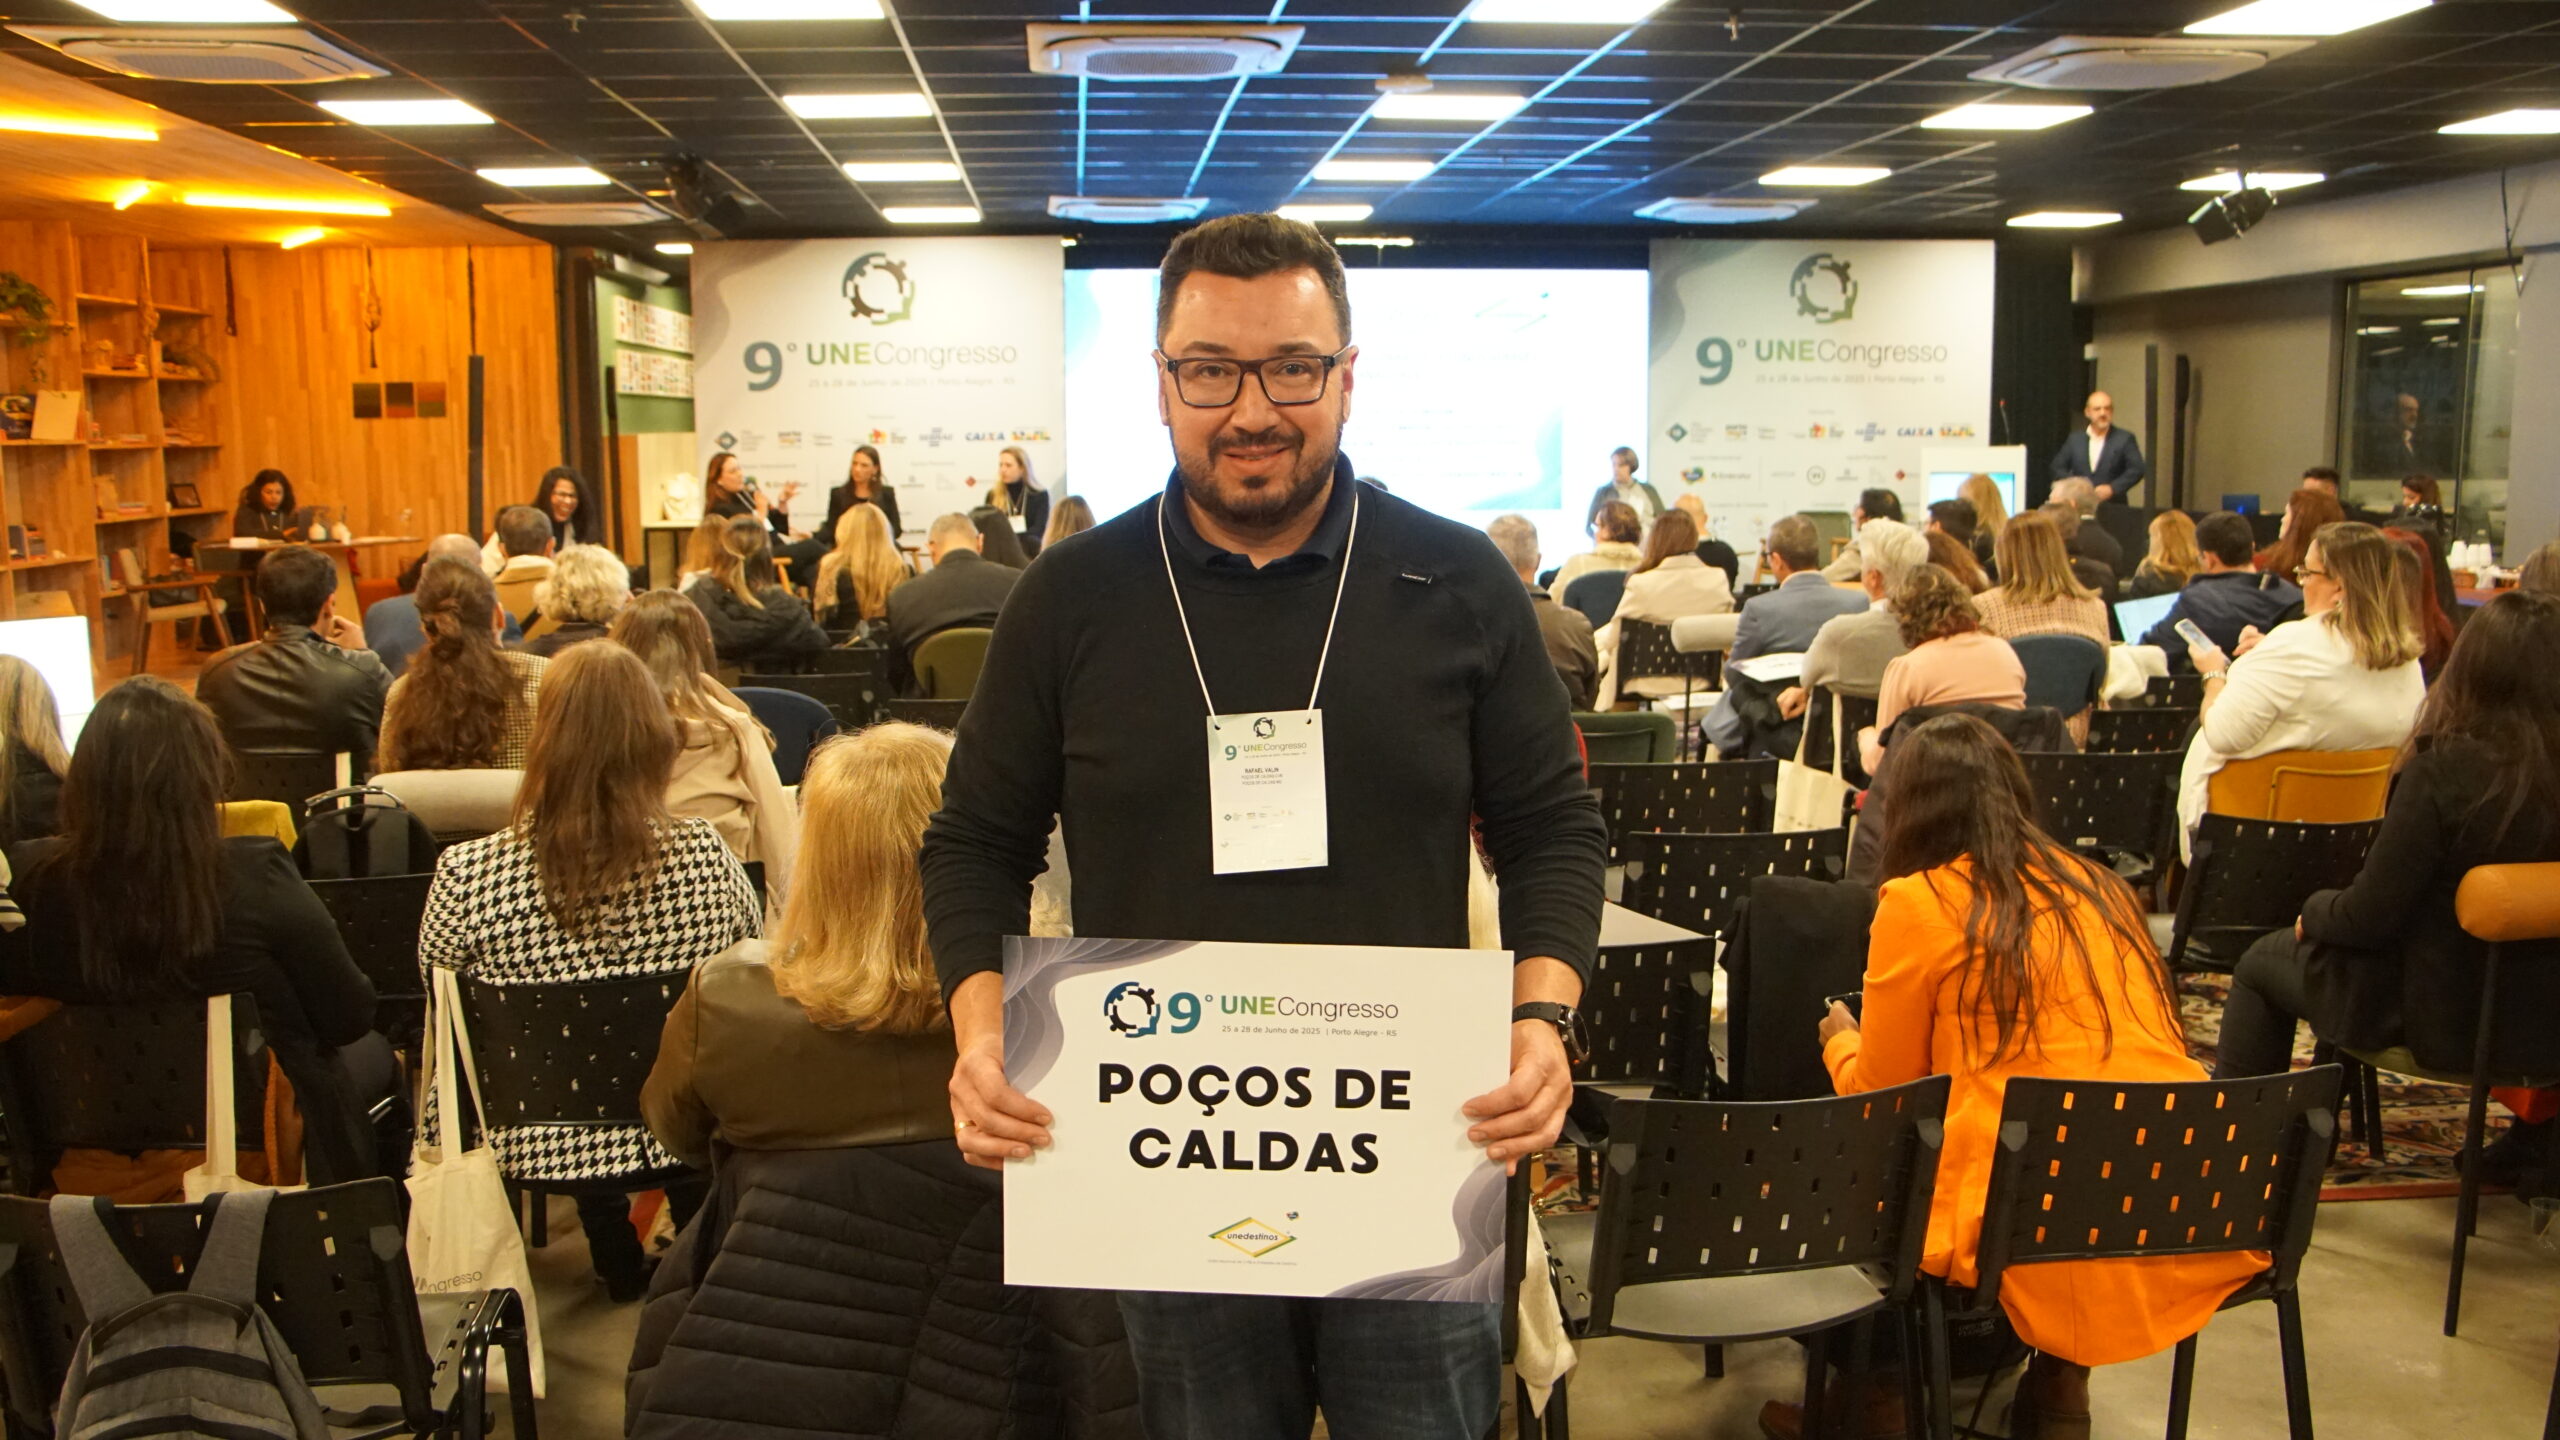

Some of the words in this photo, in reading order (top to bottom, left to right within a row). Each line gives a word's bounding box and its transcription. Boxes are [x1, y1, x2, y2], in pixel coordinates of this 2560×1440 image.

[806, 342, 1017, 369] UNECongresso
[1754, 338, 1948, 367] UNECongresso
[965, 431, 1005, 441] CAIXA
[1897, 426, 1934, 437] CAIXA
[1243, 742, 1307, 754] UNECongresso
[1220, 995, 1399, 1021] UNECongresso
[1222, 1025, 1231, 1033] 25
[1265, 1026, 1288, 1034] Junho
[1289, 1027, 1299, 1035] de
[1301, 1027, 1321, 1035] 2025
[1331, 1028, 1351, 1036] Porto
[1353, 1028, 1378, 1038] Alegre
[1386, 1029, 1398, 1037] RS
[1099, 1063, 1312, 1117] POÇOS
[1335, 1068, 1411, 1110] DE
[1129, 1127, 1379, 1174] CALDAS
[1226, 1232, 1279, 1241] unedestinos
